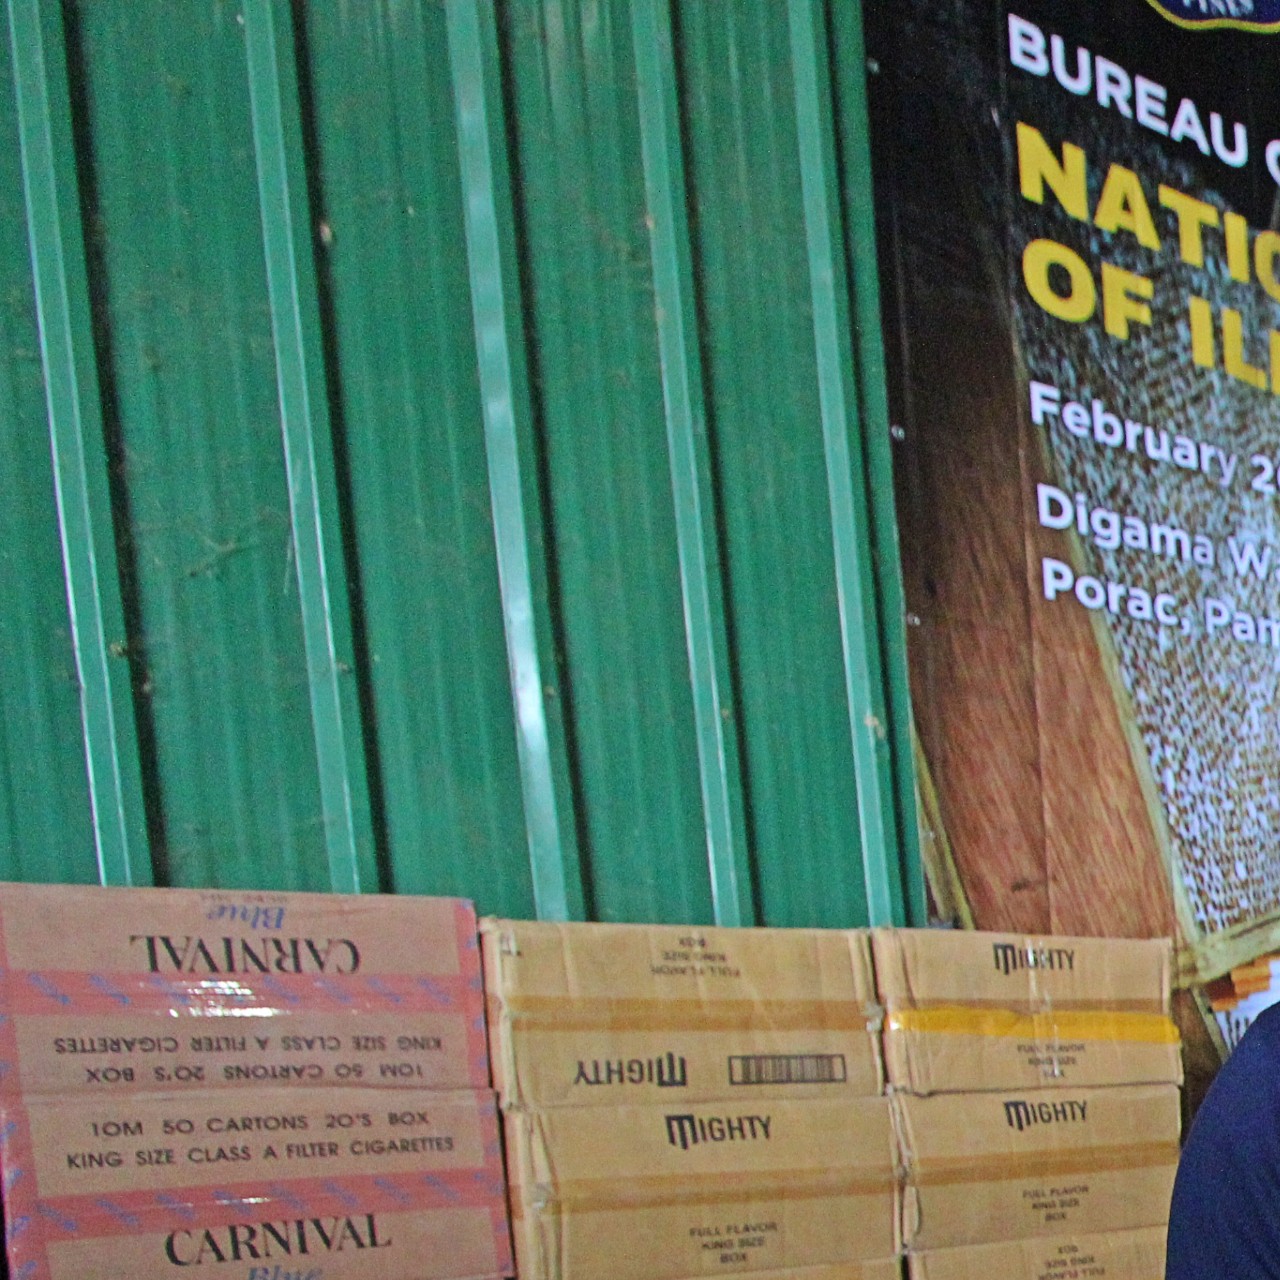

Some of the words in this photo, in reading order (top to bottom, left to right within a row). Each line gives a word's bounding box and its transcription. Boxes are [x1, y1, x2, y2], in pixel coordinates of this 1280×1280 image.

[1009, 14, 1249, 168] BUREAU
[1022, 238, 1152, 341] OF
[1030, 382, 1239, 488] February
[1038, 483, 1213, 568] Digama
[1042, 558, 1189, 636] Porac,
[207, 905, 285, 929] Blue
[130, 934, 360, 975] CARNIVAL
[992, 943, 1075, 976] MIGHTY
[54, 1038, 179, 1054] CIGARETTES
[191, 1037, 247, 1052] FILTER
[255, 1038, 269, 1052] A
[282, 1036, 340, 1052] CLASS
[355, 1036, 386, 1051] SIZE
[397, 1037, 442, 1051] KING
[87, 1067, 135, 1084] BOX
[224, 1065, 323, 1081] CARTONS
[574, 1052, 687, 1088] MIGHTY
[207, 1114, 308, 1133] CARTONS
[389, 1111, 428, 1126] BOX
[1004, 1101, 1087, 1132] MIGHTY
[666, 1114, 771, 1150] MIGHTY
[67, 1151, 123, 1171] KING
[136, 1148, 174, 1165] SIZE
[188, 1145, 251, 1164] CLASS
[263, 1144, 278, 1159] A
[286, 1142, 338, 1159] FILTER
[350, 1136, 454, 1155] CIGARETTES
[1022, 1188, 1049, 1200] FULL
[1051, 1185, 1090, 1198] FLAVOR
[165, 1213, 391, 1266] CARNIVAL
[689, 1226, 723, 1239] FULL
[725, 1222, 778, 1237] FLAVOR
[702, 1238, 732, 1250] KING
[735, 1236, 765, 1248] SIZE
[720, 1252, 748, 1264] BOX
